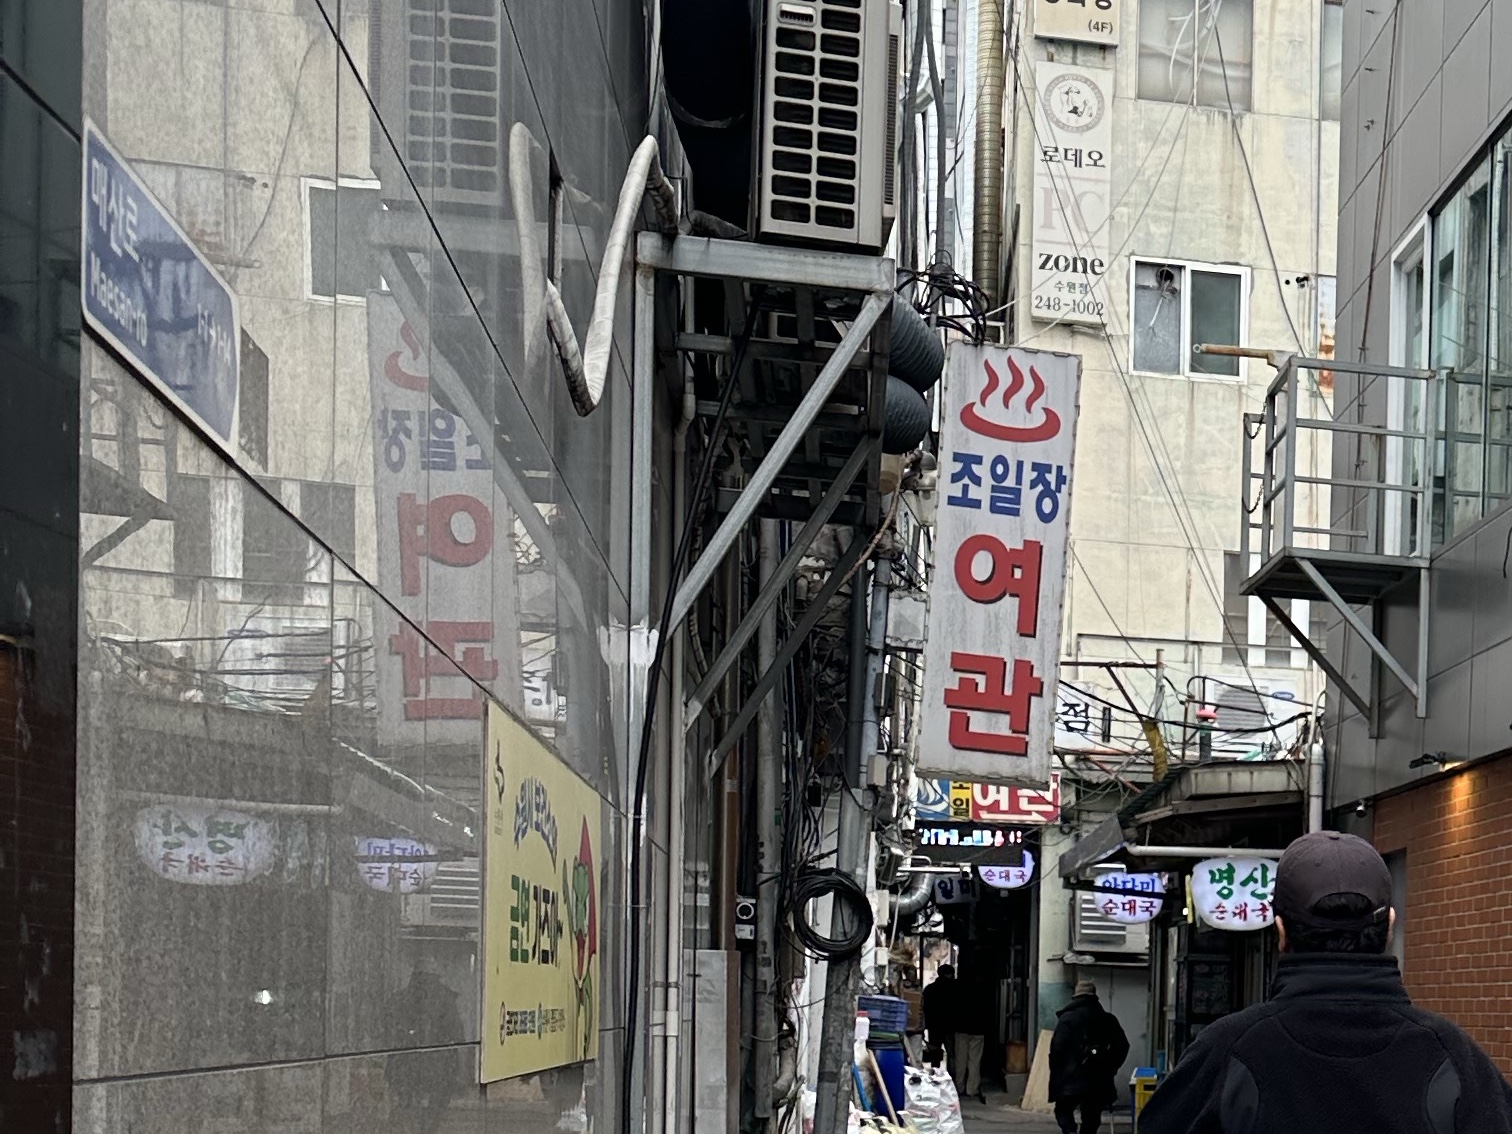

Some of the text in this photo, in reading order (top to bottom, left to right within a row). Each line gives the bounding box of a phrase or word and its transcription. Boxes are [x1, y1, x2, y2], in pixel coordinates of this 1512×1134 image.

[1087, 19, 1113, 35] (4F)
[1040, 144, 1106, 169] 로데오
[91, 157, 141, 264] 매산로
[1039, 186, 1106, 234] PC
[1038, 252, 1105, 276] zone
[91, 250, 148, 347] Maesan-ro
[1034, 295, 1104, 317] 248-1002
[947, 451, 1067, 524] 조일장
[944, 534, 1044, 757] 여관
[983, 868, 1027, 883] 순대국
[1209, 862, 1276, 900] 명산
[510, 874, 531, 963] 금연
[1102, 898, 1157, 917] 순대국
[1209, 902, 1270, 923] 순대국
